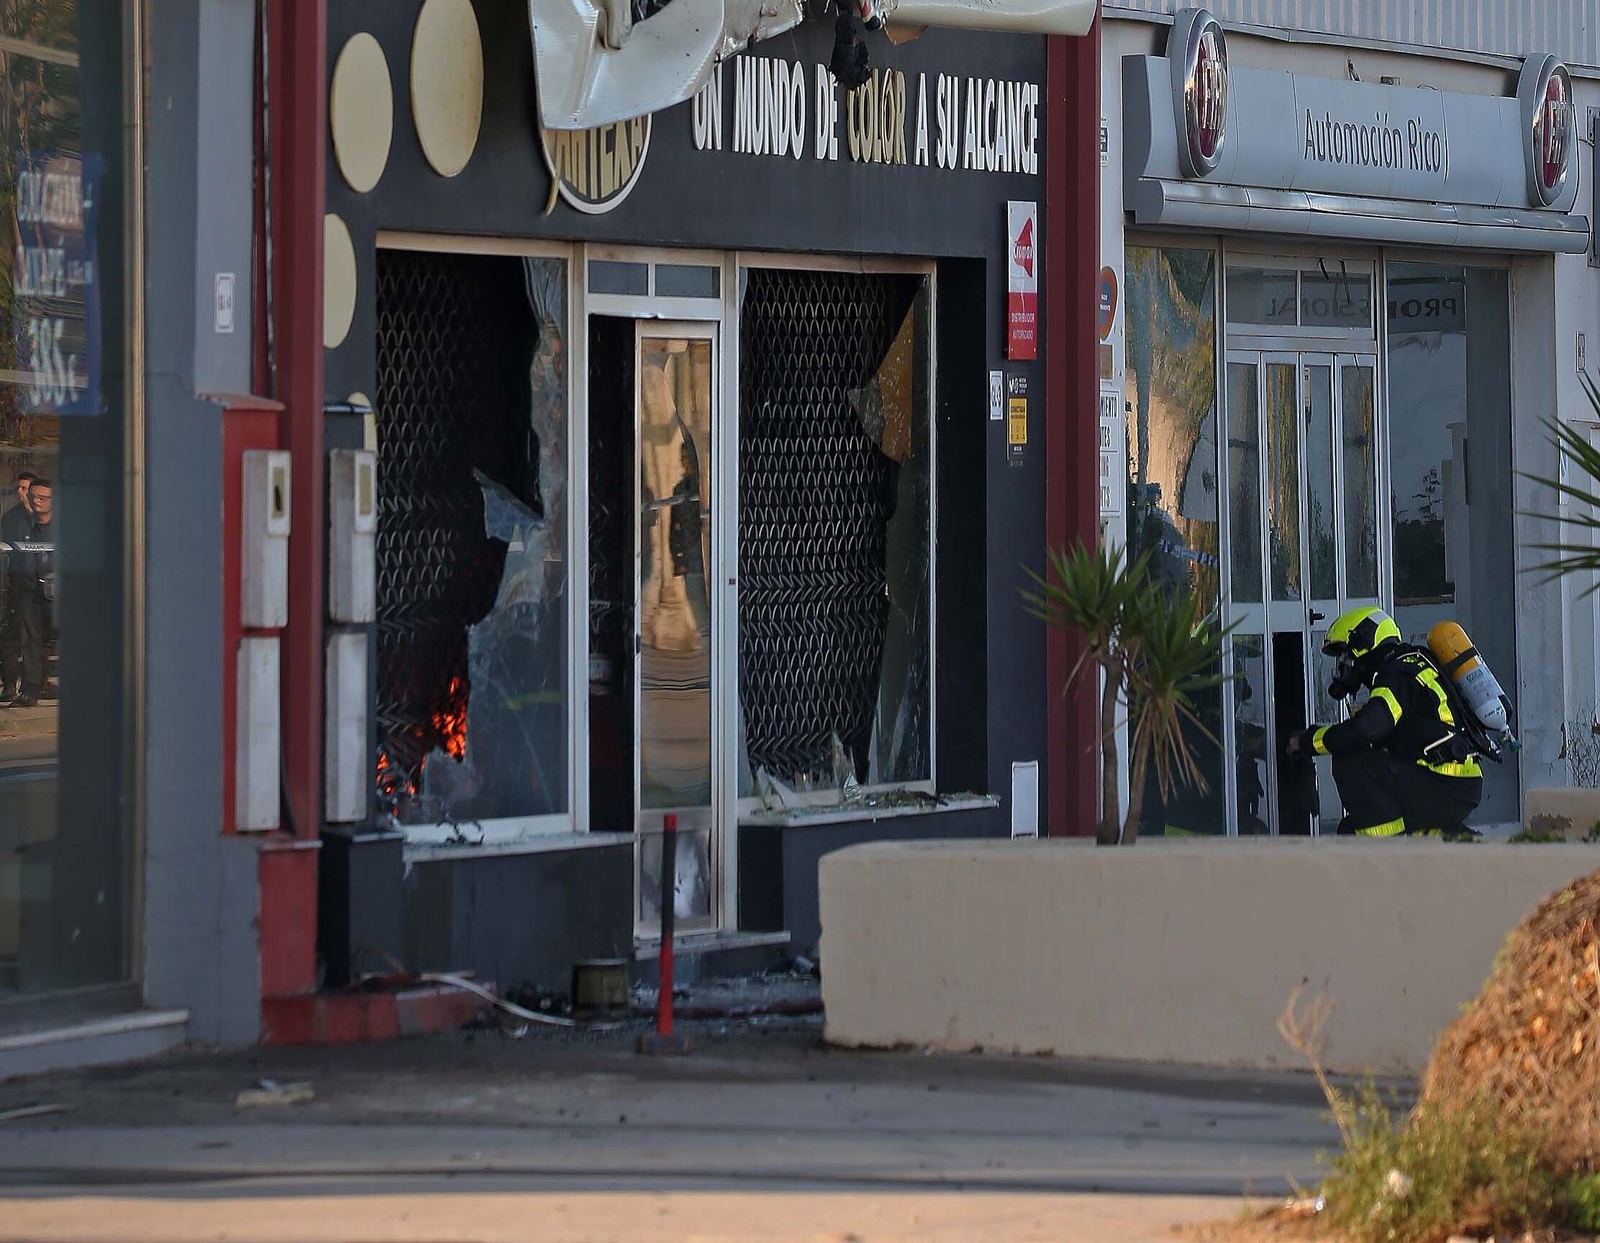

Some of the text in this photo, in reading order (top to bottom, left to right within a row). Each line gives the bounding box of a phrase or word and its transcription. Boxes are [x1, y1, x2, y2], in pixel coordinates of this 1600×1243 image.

[692, 63, 723, 151] UN
[733, 55, 805, 160] MUNDO
[816, 63, 838, 161] DE
[847, 68, 907, 165] COLOR
[915, 72, 929, 167] A
[937, 72, 959, 170] SU
[963, 77, 1039, 175] ALCANCE
[1304, 108, 1441, 173] Automoción Rico
